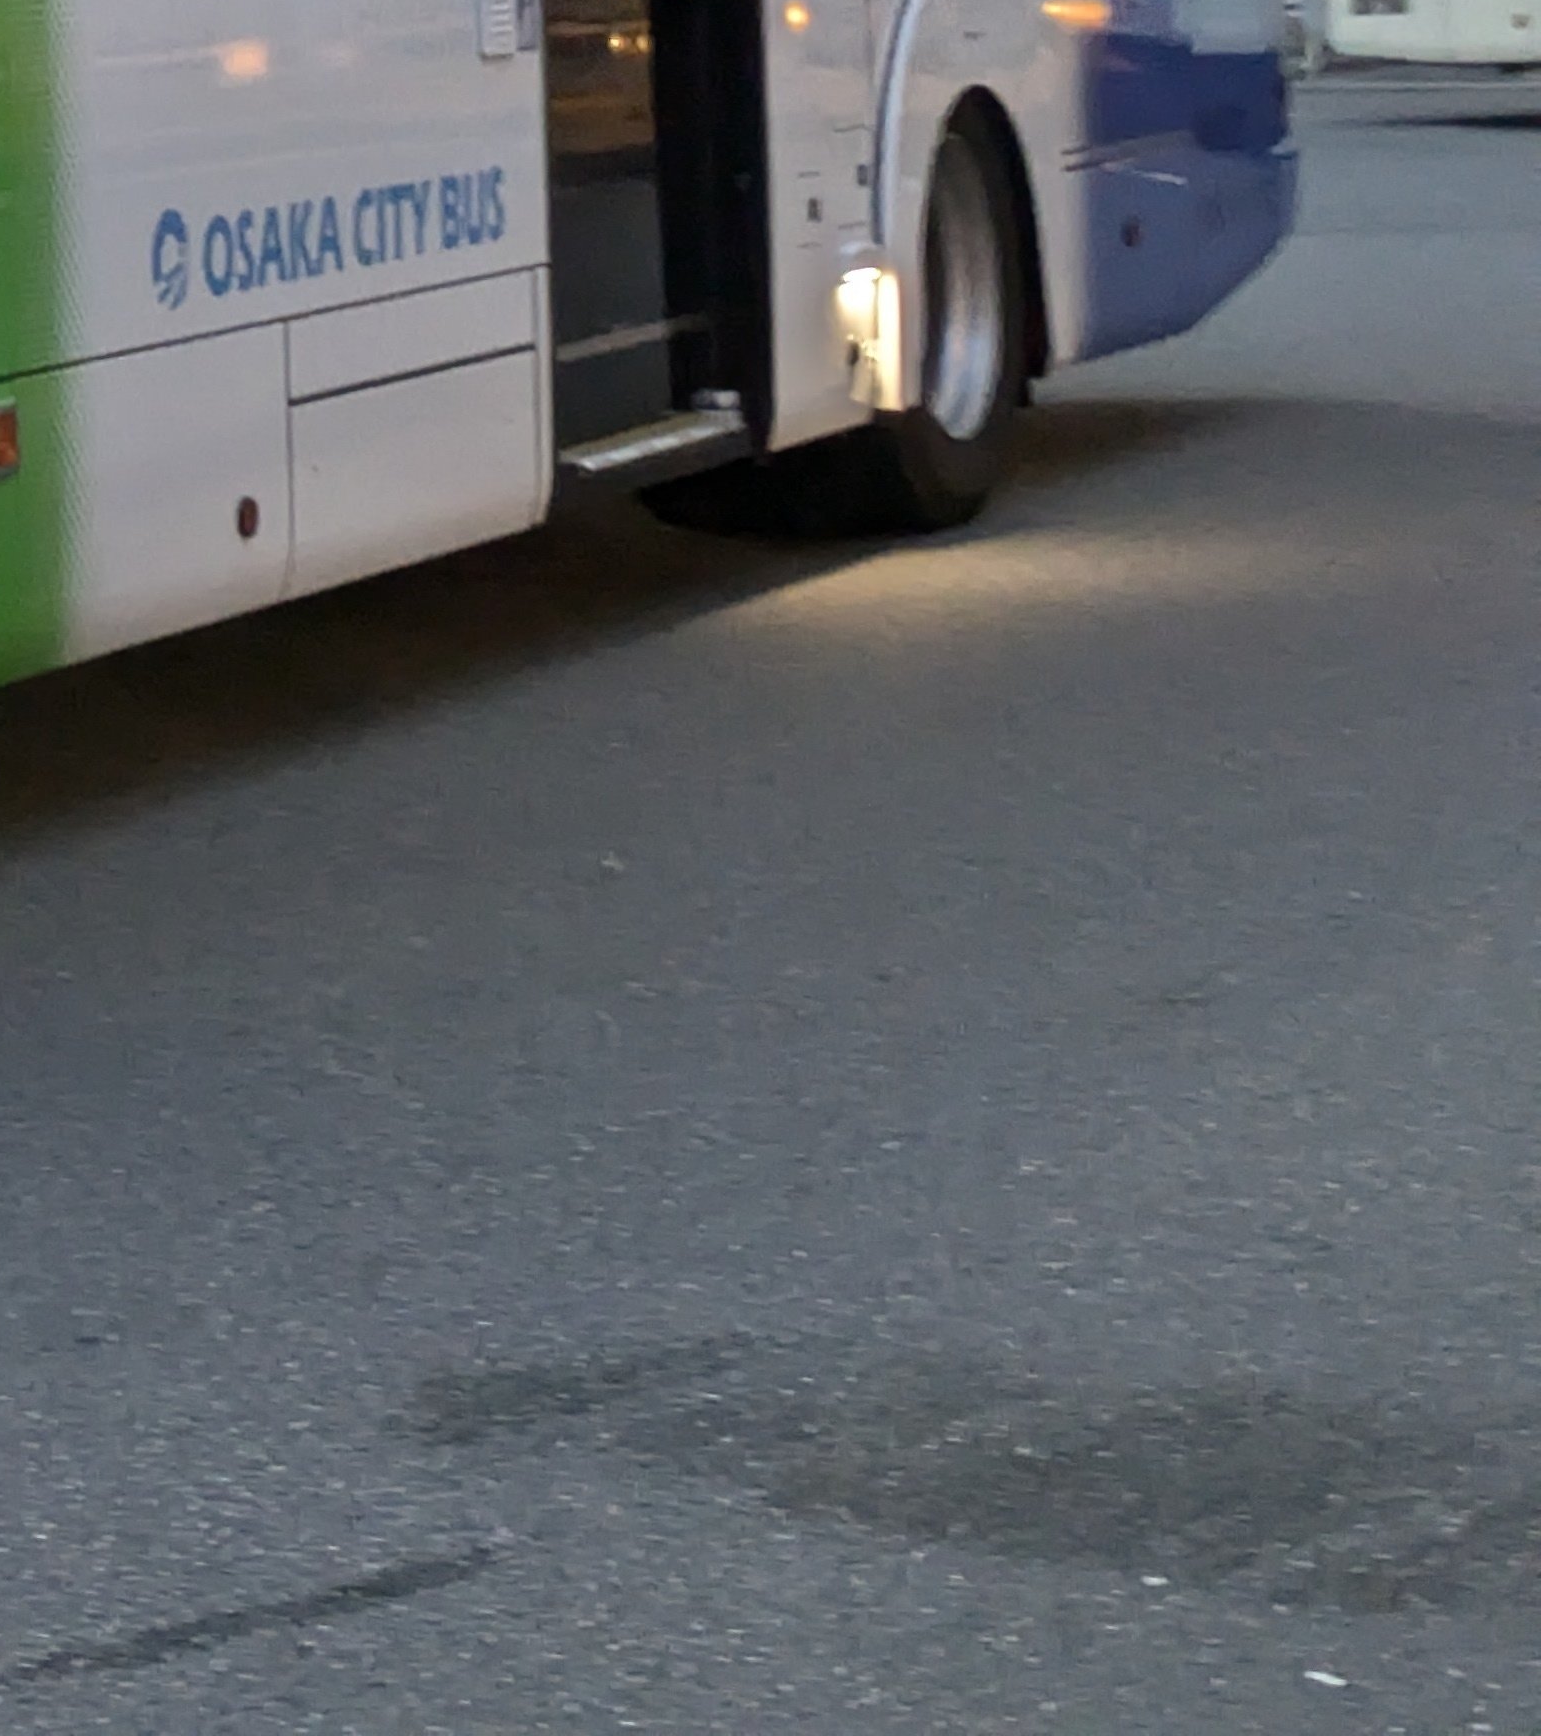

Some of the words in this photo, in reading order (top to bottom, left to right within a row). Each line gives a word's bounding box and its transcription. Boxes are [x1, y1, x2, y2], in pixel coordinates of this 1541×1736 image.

[203, 194, 345, 298] OSAKA
[353, 178, 431, 267] CITY
[439, 164, 506, 251] BUS
